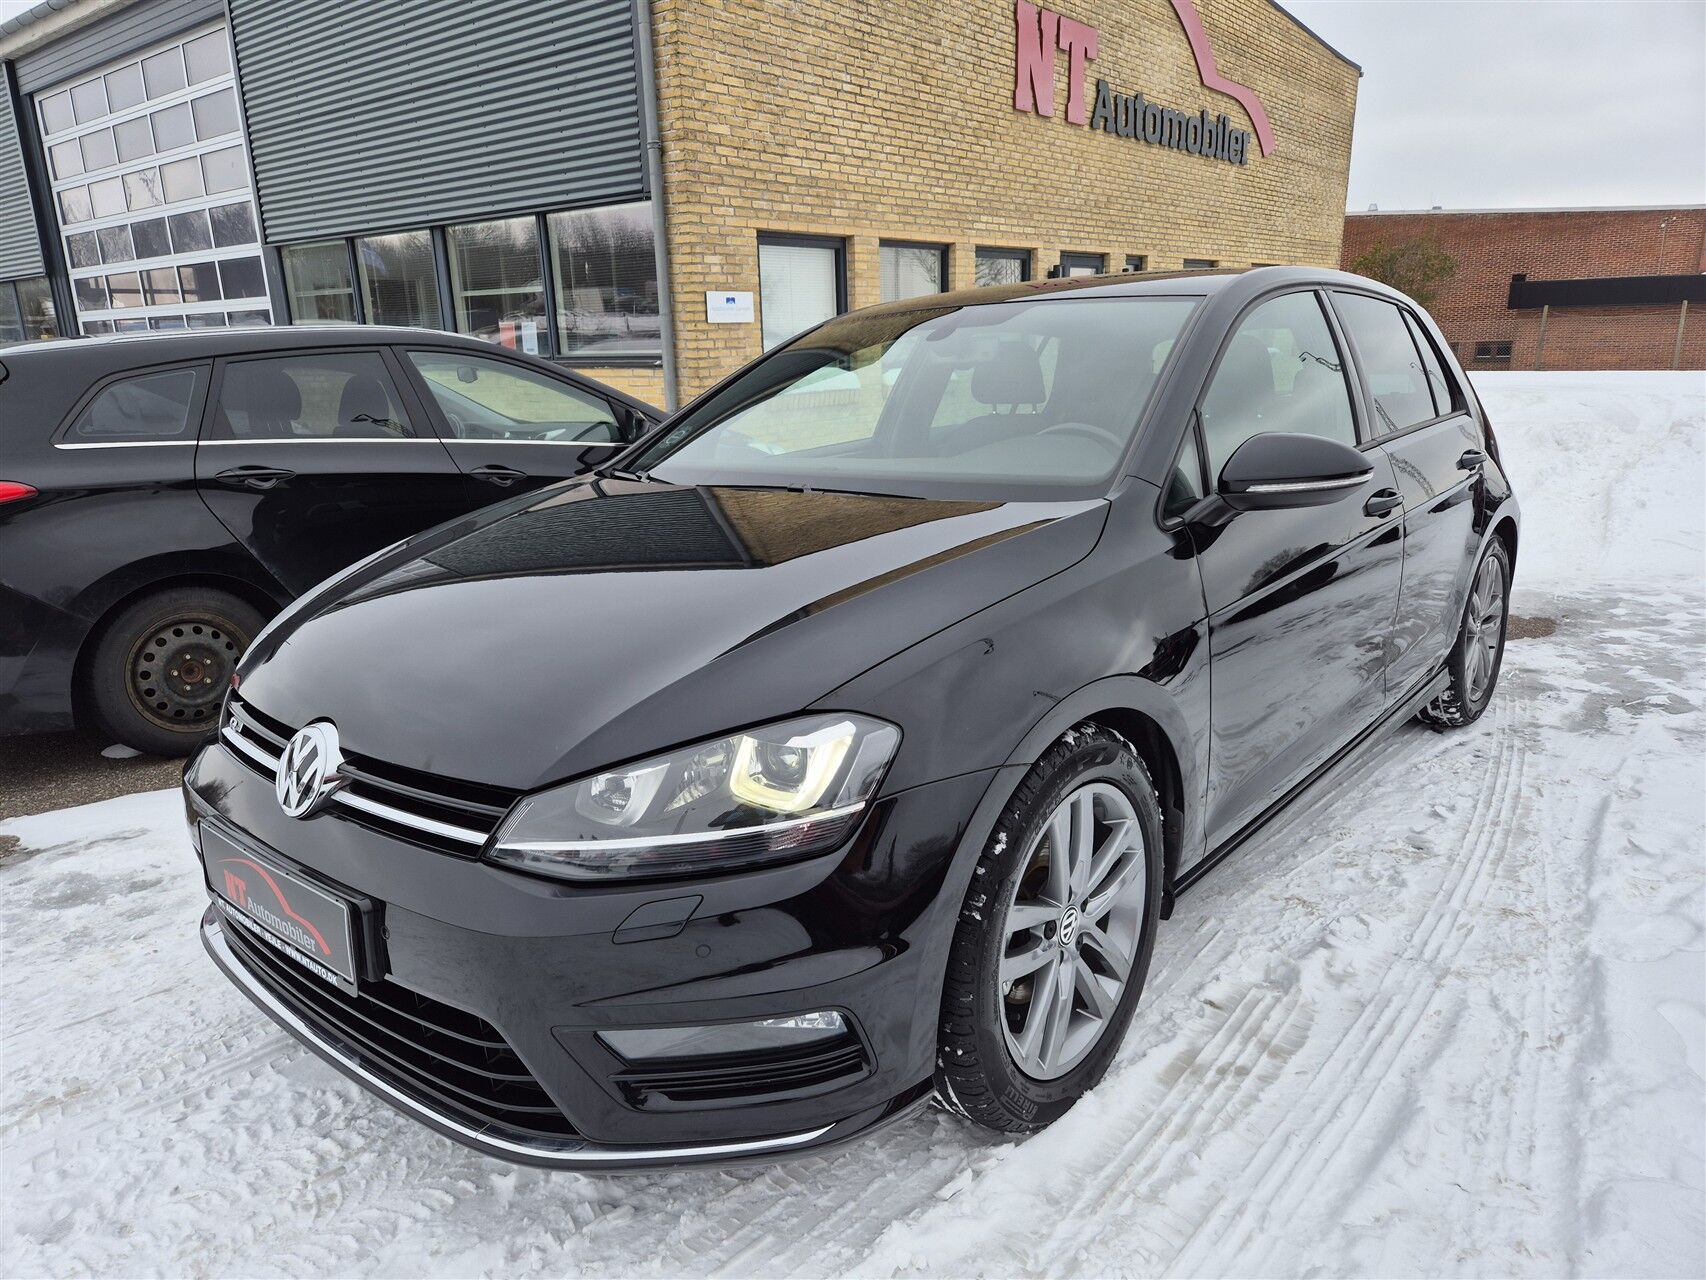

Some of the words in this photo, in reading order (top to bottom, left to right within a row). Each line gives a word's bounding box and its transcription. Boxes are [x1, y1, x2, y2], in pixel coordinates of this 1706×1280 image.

[1014, 0, 1099, 126] NT
[1090, 79, 1251, 165] Automobiler
[223, 868, 246, 907] NT
[247, 896, 317, 952] Automobiler
[284, 944, 339, 986] WWW.NTAUTO.DK
